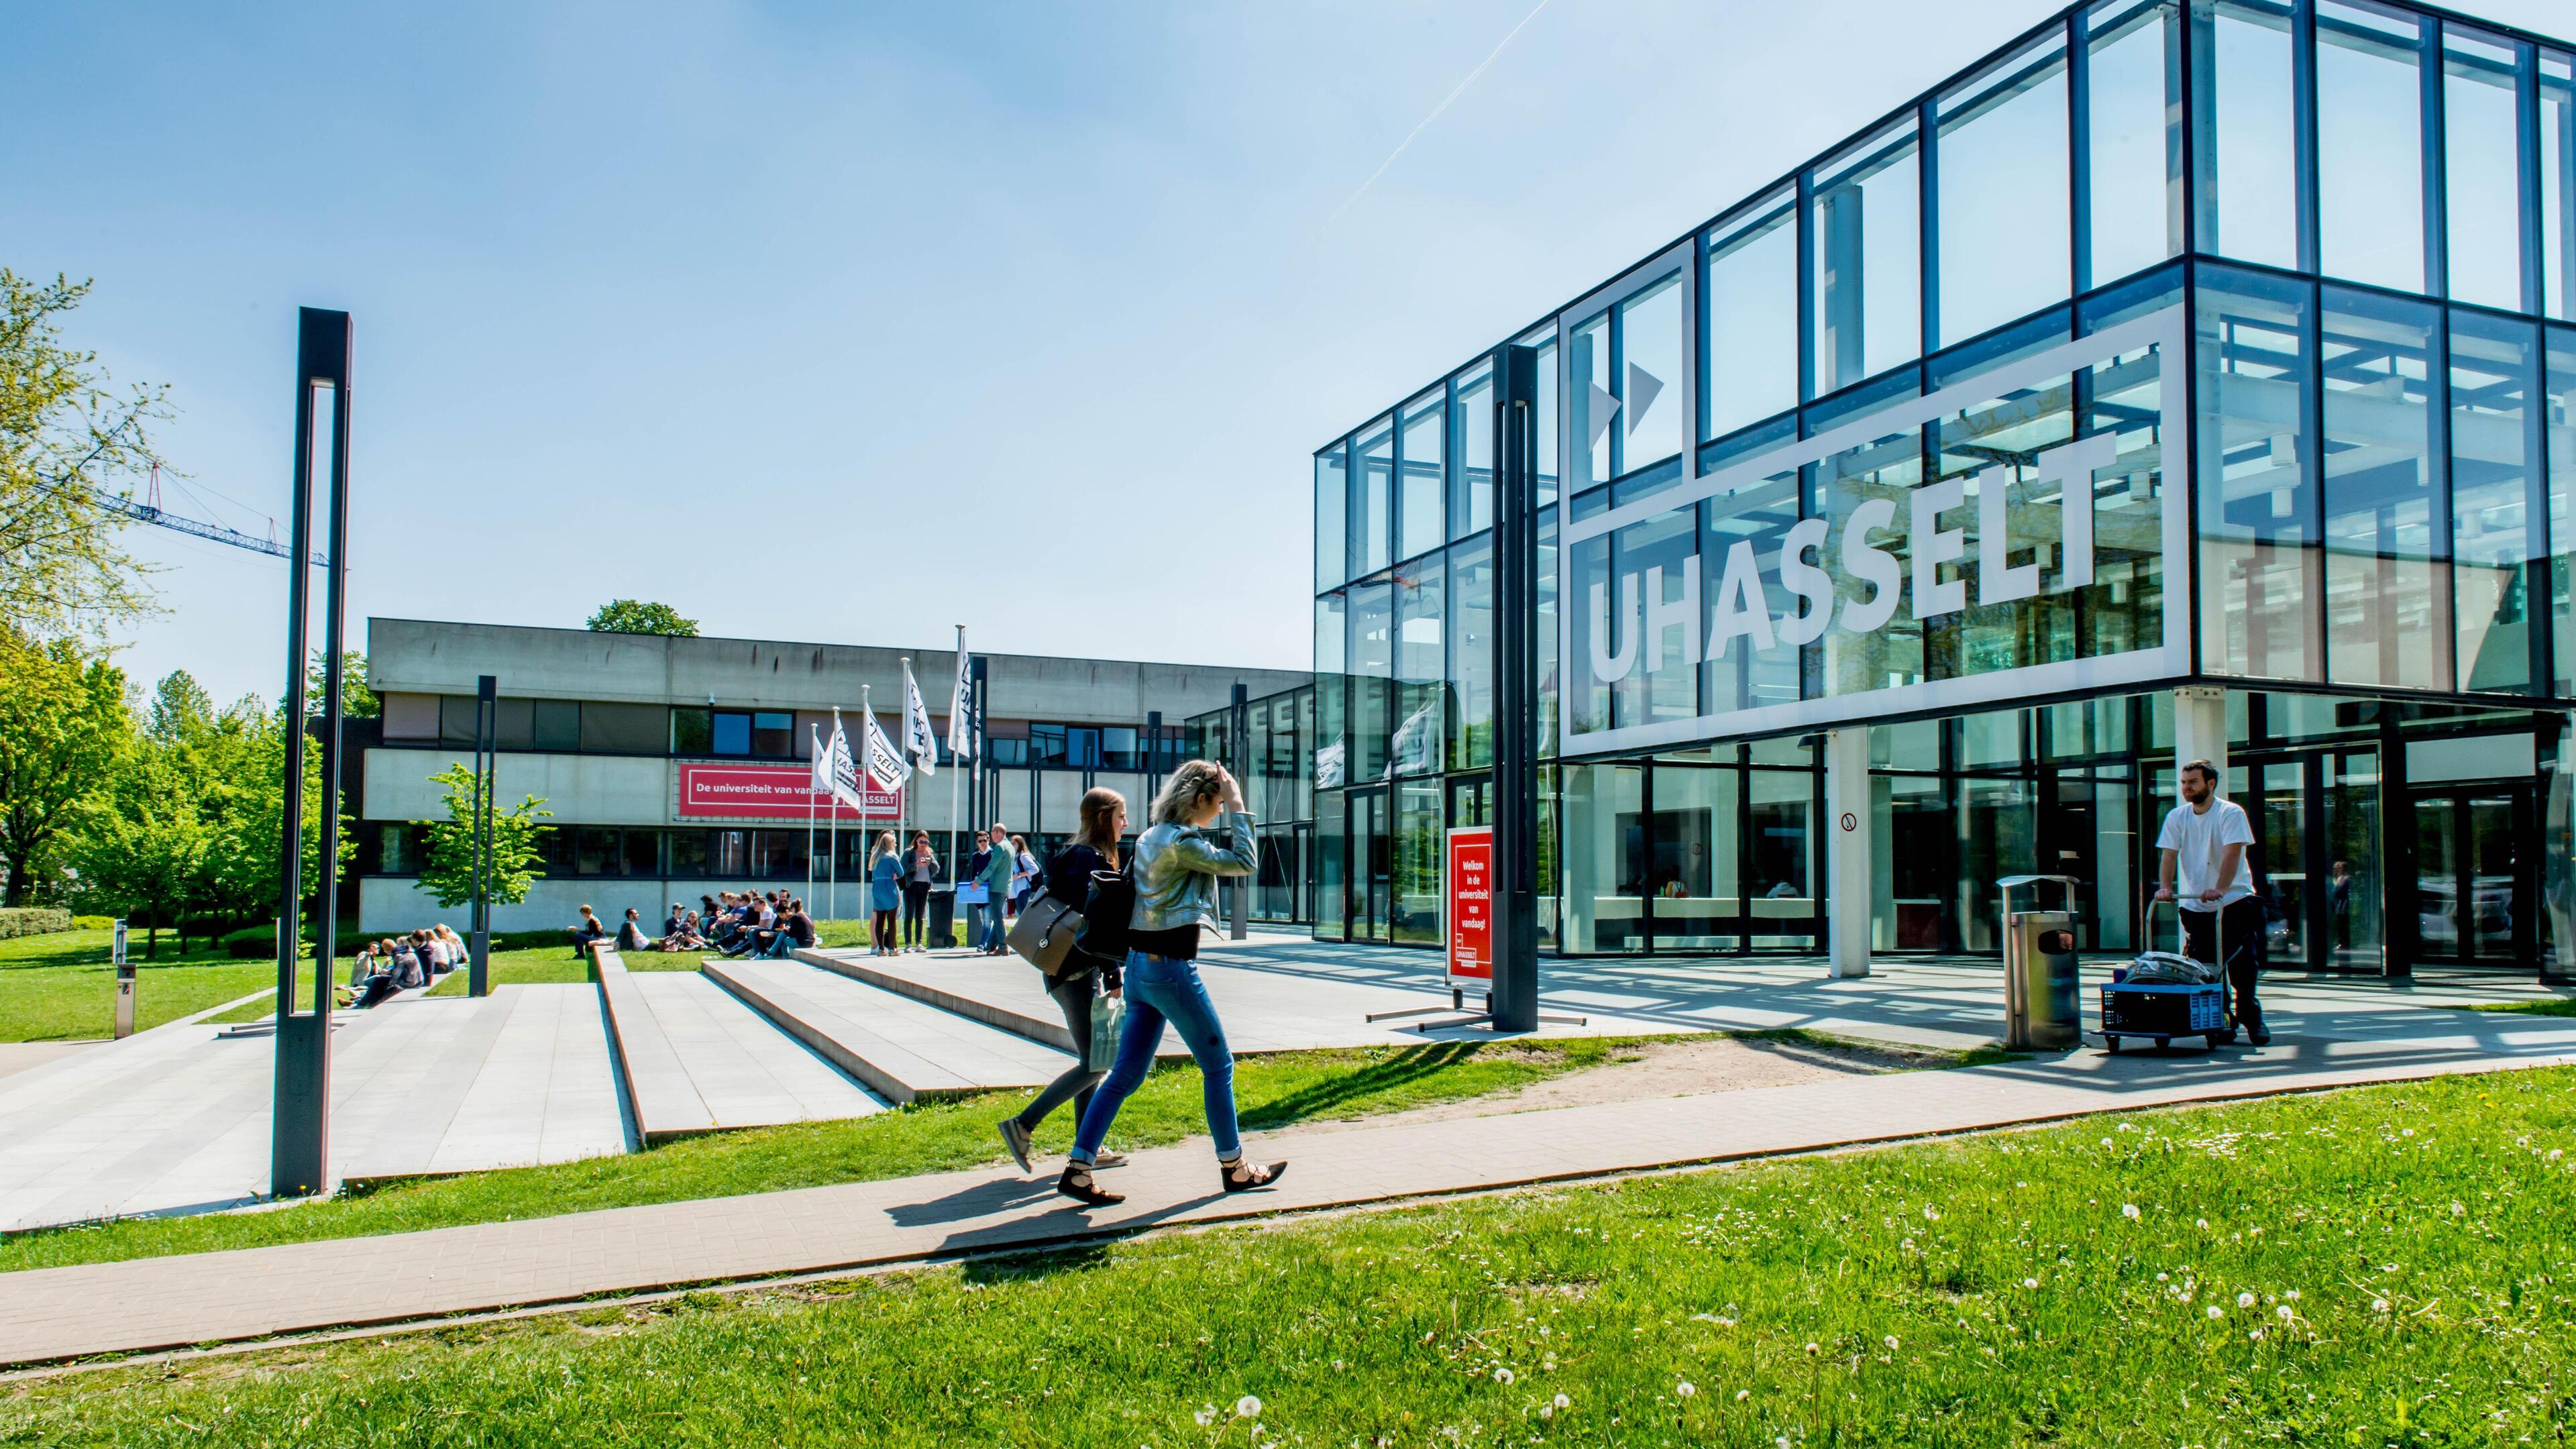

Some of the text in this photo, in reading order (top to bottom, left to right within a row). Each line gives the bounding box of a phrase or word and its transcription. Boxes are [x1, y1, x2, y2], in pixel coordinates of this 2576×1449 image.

[1590, 431, 2116, 682] UHASSELT
[873, 749, 899, 773] SSELT
[696, 784, 710, 792] De
[713, 784, 772, 794] universiteit
[859, 796, 895, 804] ASSELT
[1462, 859, 1484, 871] Welkom
[1467, 874, 1480, 885] in de
[1458, 888, 1489, 900] universiteit
[1468, 906, 1479, 914] van
[1461, 918, 1485, 931] vandaag!
[1456, 951, 1475, 959] UHASSELT
